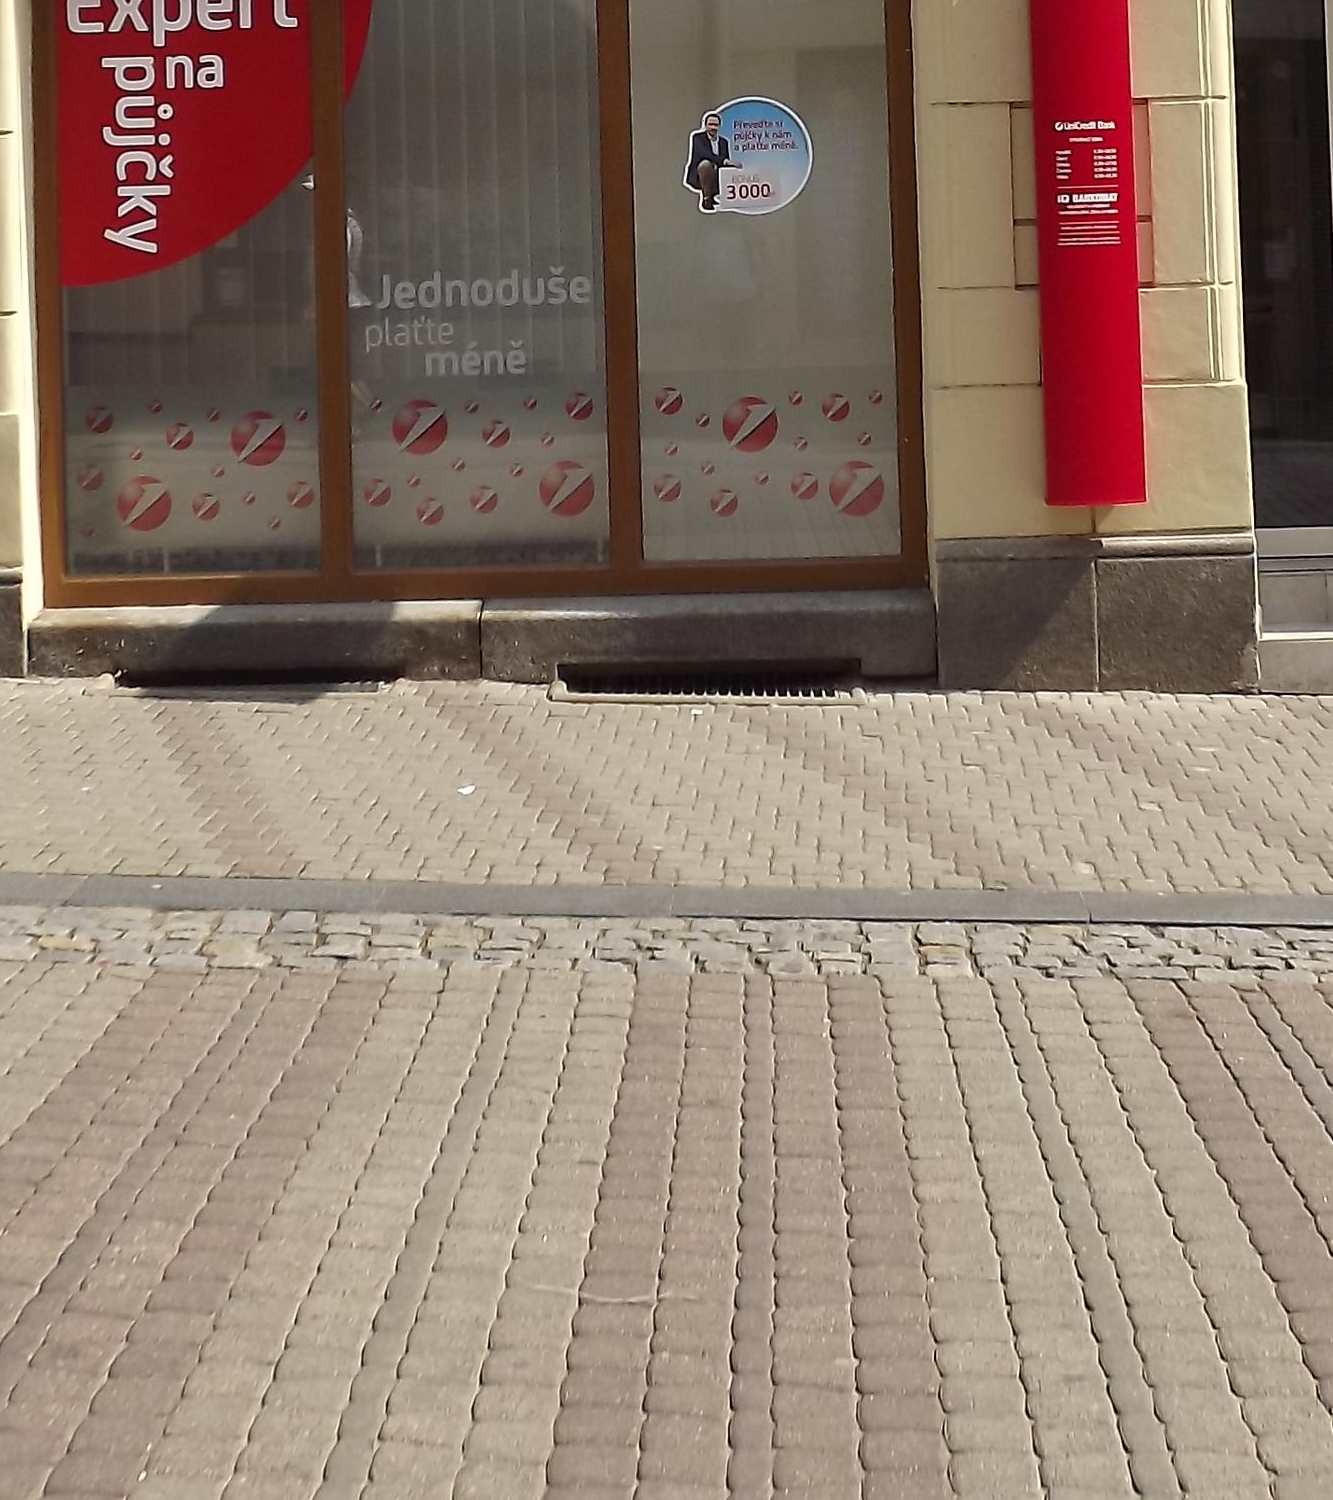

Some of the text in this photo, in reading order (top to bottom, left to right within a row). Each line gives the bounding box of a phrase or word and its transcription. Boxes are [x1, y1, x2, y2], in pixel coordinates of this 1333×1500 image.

[165, 54, 225, 89] na
[764, 130, 770, 140] k
[101, 56, 175, 254] půjčky
[376, 265, 593, 310] Jednoduše
[365, 316, 455, 353] plaťte
[424, 339, 528, 377] méně
